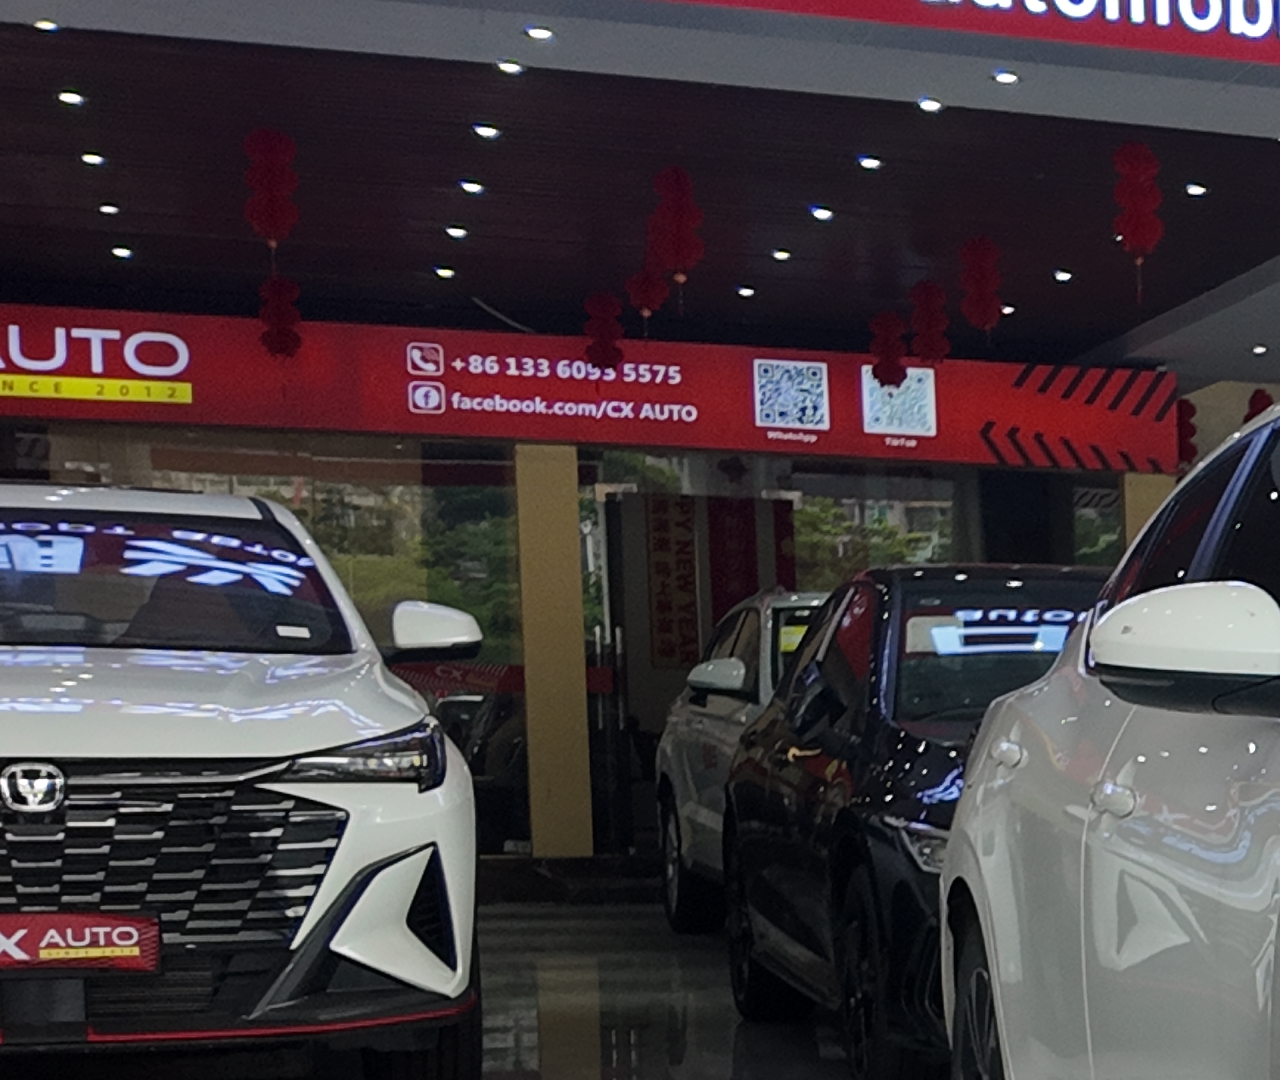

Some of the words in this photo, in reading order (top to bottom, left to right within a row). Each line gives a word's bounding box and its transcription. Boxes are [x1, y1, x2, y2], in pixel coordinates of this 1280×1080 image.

[0, 324, 190, 377] UTO
[451, 354, 499, 375] +86
[505, 356, 551, 377] 133
[622, 363, 683, 385] 5575
[2, 379, 64, 395] NCE
[95, 383, 178, 399] 2012
[450, 391, 635, 420] facebook.com/CX
[639, 404, 698, 423] AUTO
[0, 928, 32, 961] X
[38, 926, 140, 948] AUTO
